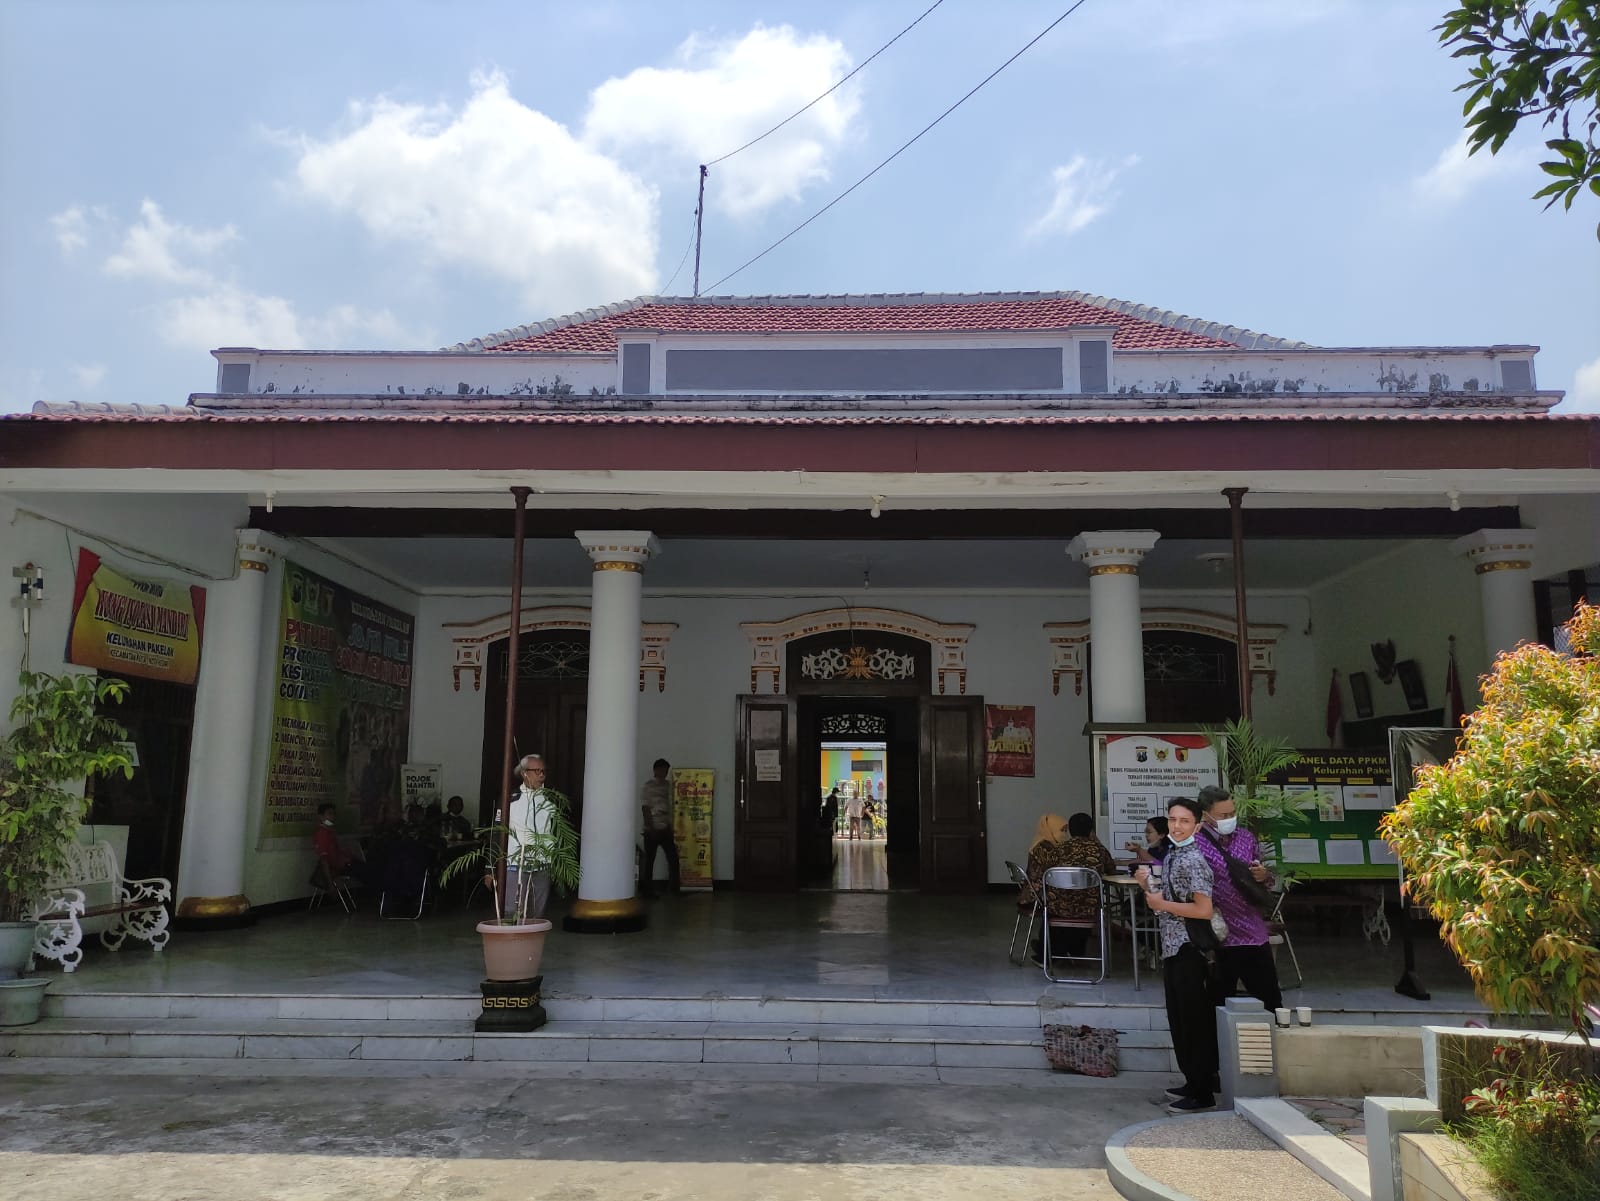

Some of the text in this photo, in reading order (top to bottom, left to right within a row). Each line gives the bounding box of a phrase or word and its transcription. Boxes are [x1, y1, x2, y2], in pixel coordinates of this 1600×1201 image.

[106, 632, 175, 657] KELURAHAN PAKELAN
[1296, 756, 1327, 765] ANEL
[1358, 757, 1387, 765] PPKM
[1313, 766, 1364, 775] Kelurahan
